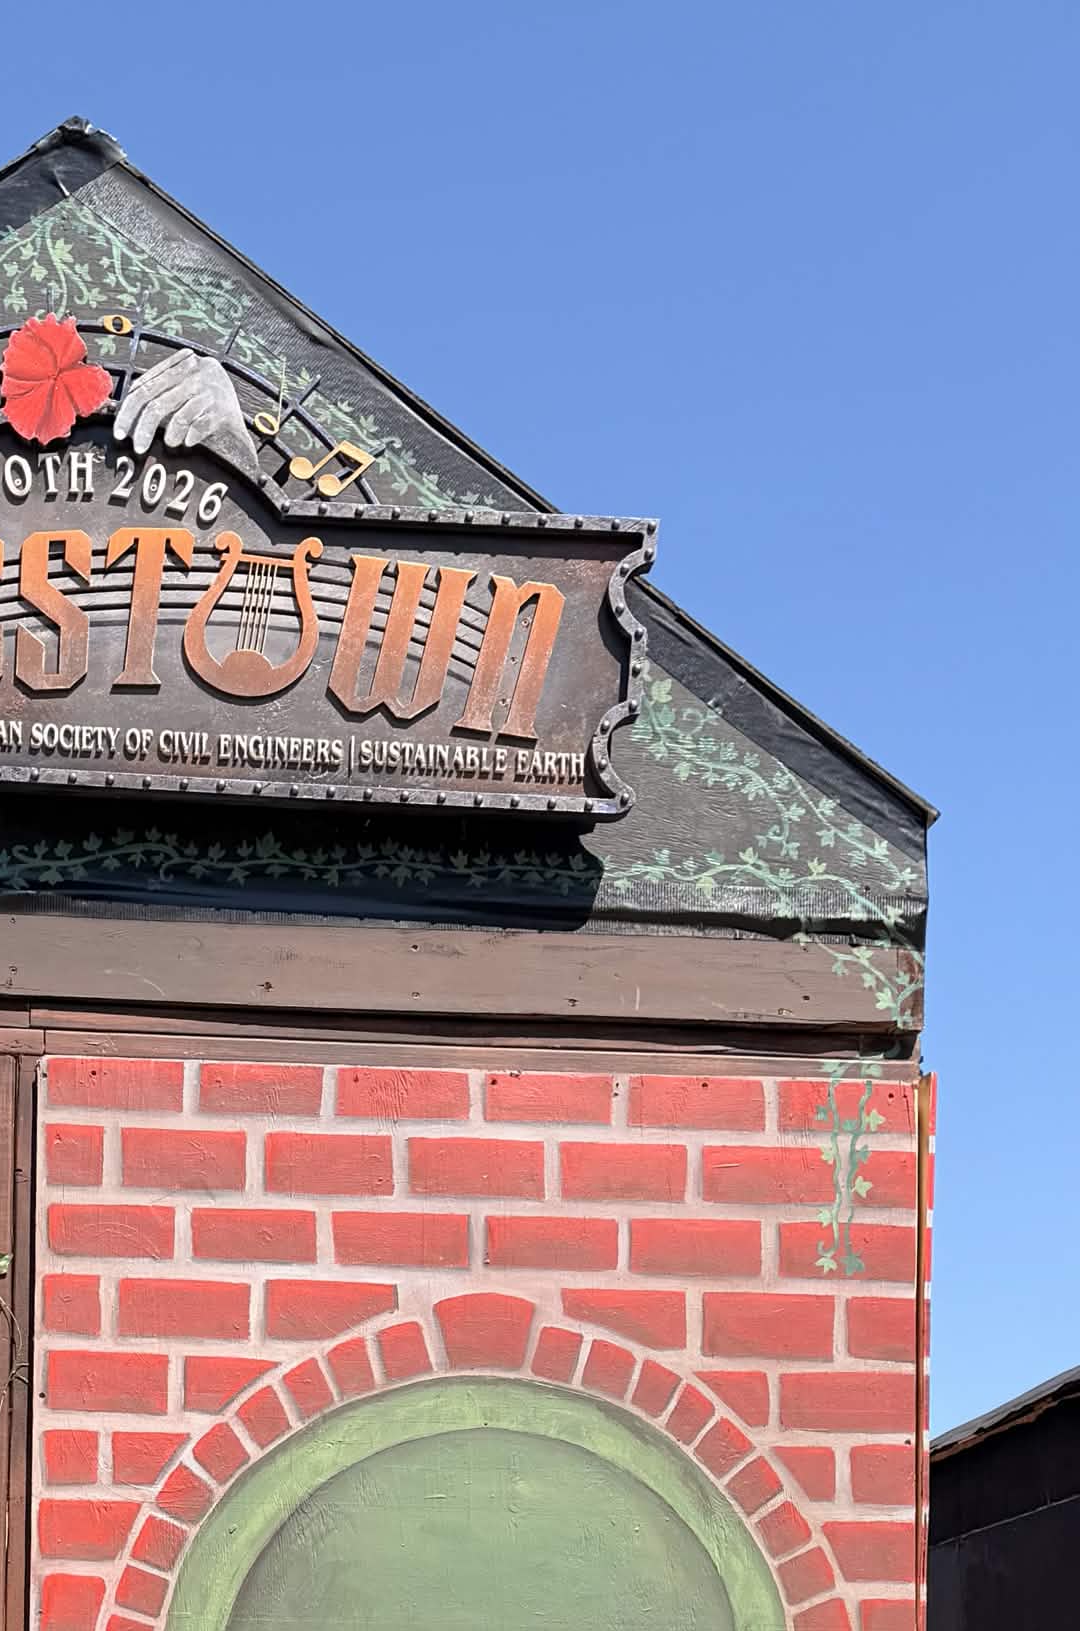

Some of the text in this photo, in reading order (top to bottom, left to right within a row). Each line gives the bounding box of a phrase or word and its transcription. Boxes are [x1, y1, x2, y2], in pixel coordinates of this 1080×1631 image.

[112, 456, 229, 522] 2026
[30, 722, 121, 752] SOCIETY
[125, 728, 154, 753] OF
[159, 730, 212, 757] CIVIL
[219, 734, 343, 764] ENGINEERS
[360, 740, 508, 773] SUSTAINABLE
[517, 750, 585, 777] EARTH
